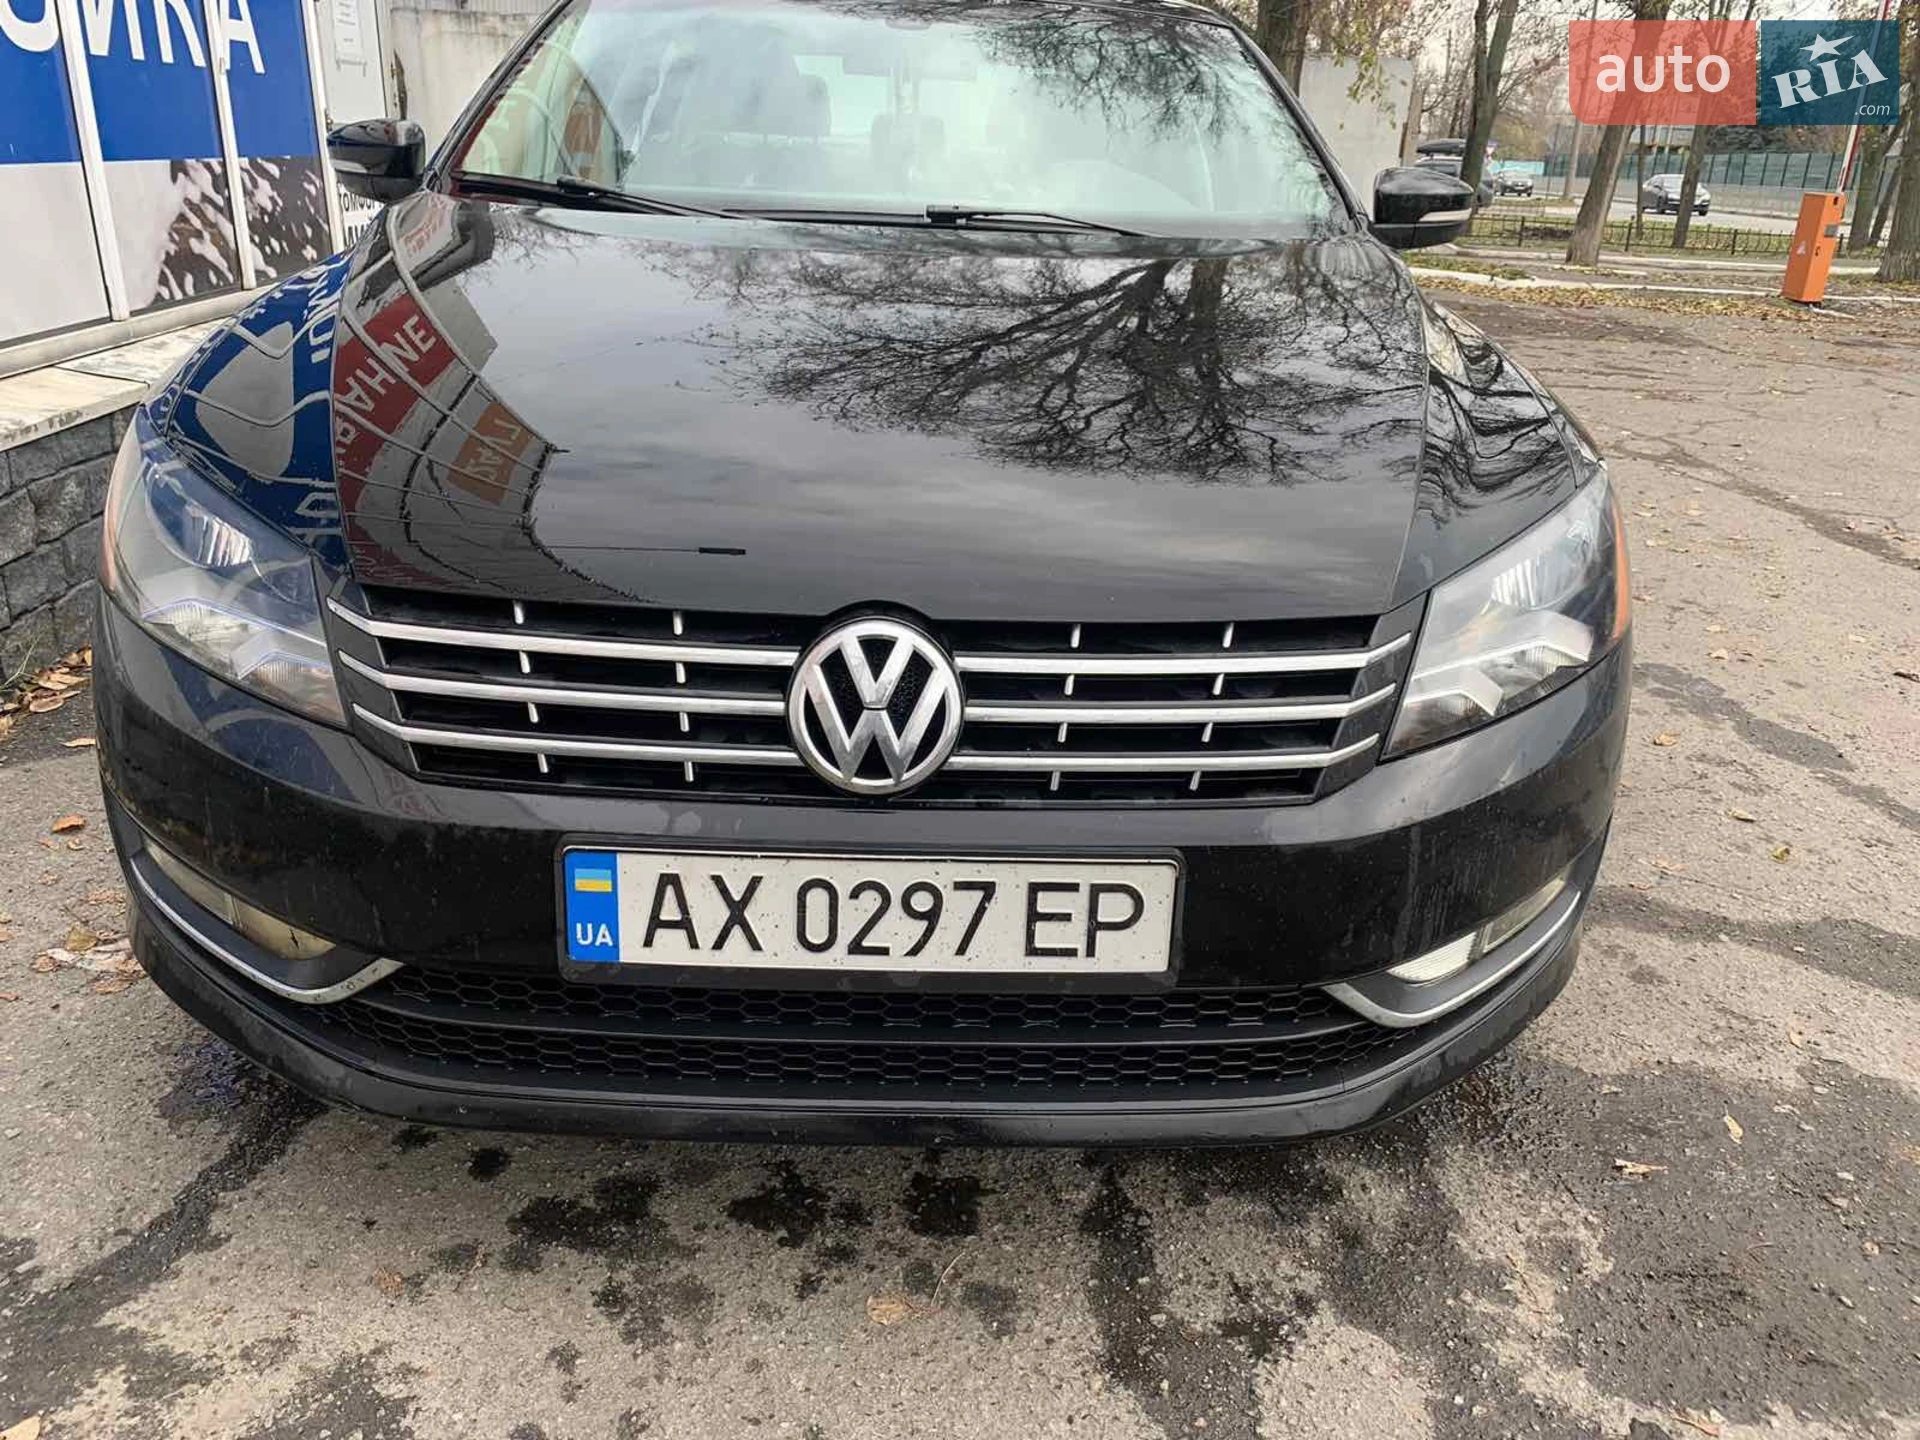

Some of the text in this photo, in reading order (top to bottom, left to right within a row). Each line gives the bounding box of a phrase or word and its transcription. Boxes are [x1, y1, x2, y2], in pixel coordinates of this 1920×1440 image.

[575, 922, 614, 947] UA
[642, 872, 1145, 958] AX 0297 EP
